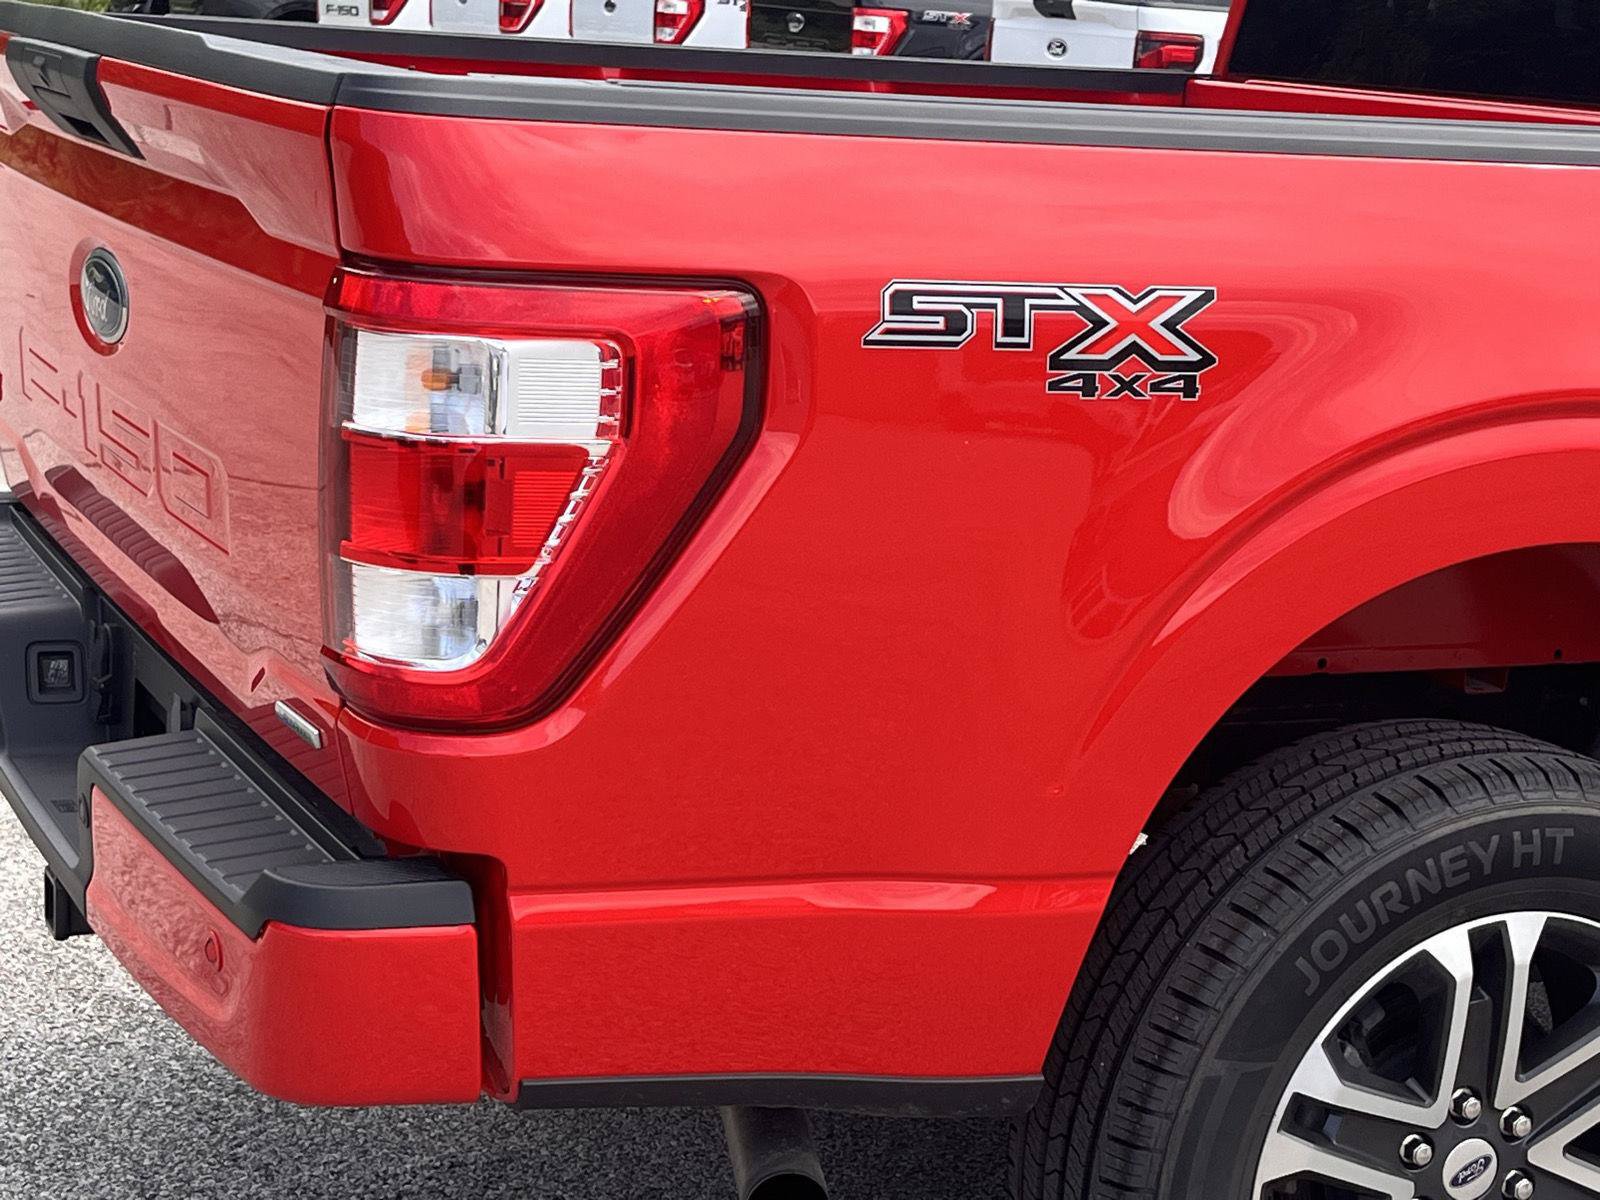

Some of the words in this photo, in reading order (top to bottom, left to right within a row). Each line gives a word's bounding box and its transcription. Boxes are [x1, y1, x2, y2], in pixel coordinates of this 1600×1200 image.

[922, 10, 973, 25] STX
[861, 278, 1218, 373] STX
[1294, 834, 1500, 997] JOURNEY
[1512, 827, 1575, 868] HT
[1457, 1157, 1486, 1184] Ford
